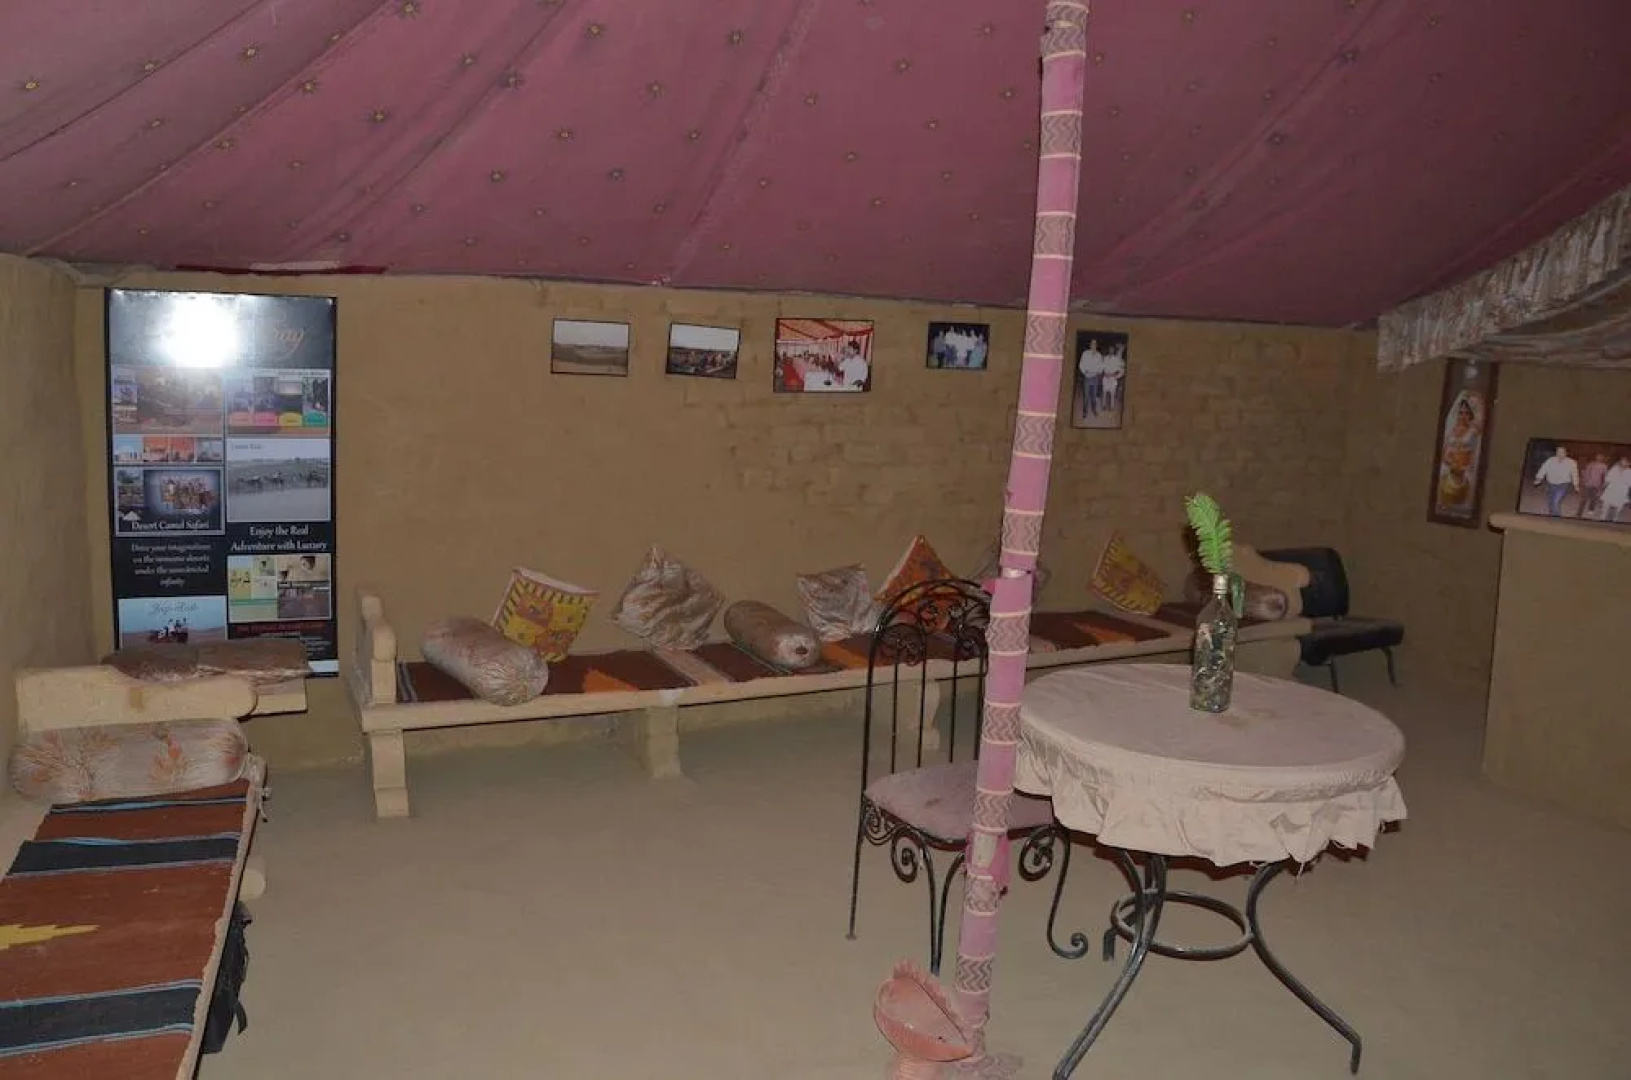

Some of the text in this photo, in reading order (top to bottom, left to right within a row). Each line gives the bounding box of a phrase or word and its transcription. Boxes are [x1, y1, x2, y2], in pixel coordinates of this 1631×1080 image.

[131, 519, 210, 532] Desert Camel Safari
[250, 524, 309, 538] Enjoy the Real
[230, 539, 327, 551] Adventure with Luxury
